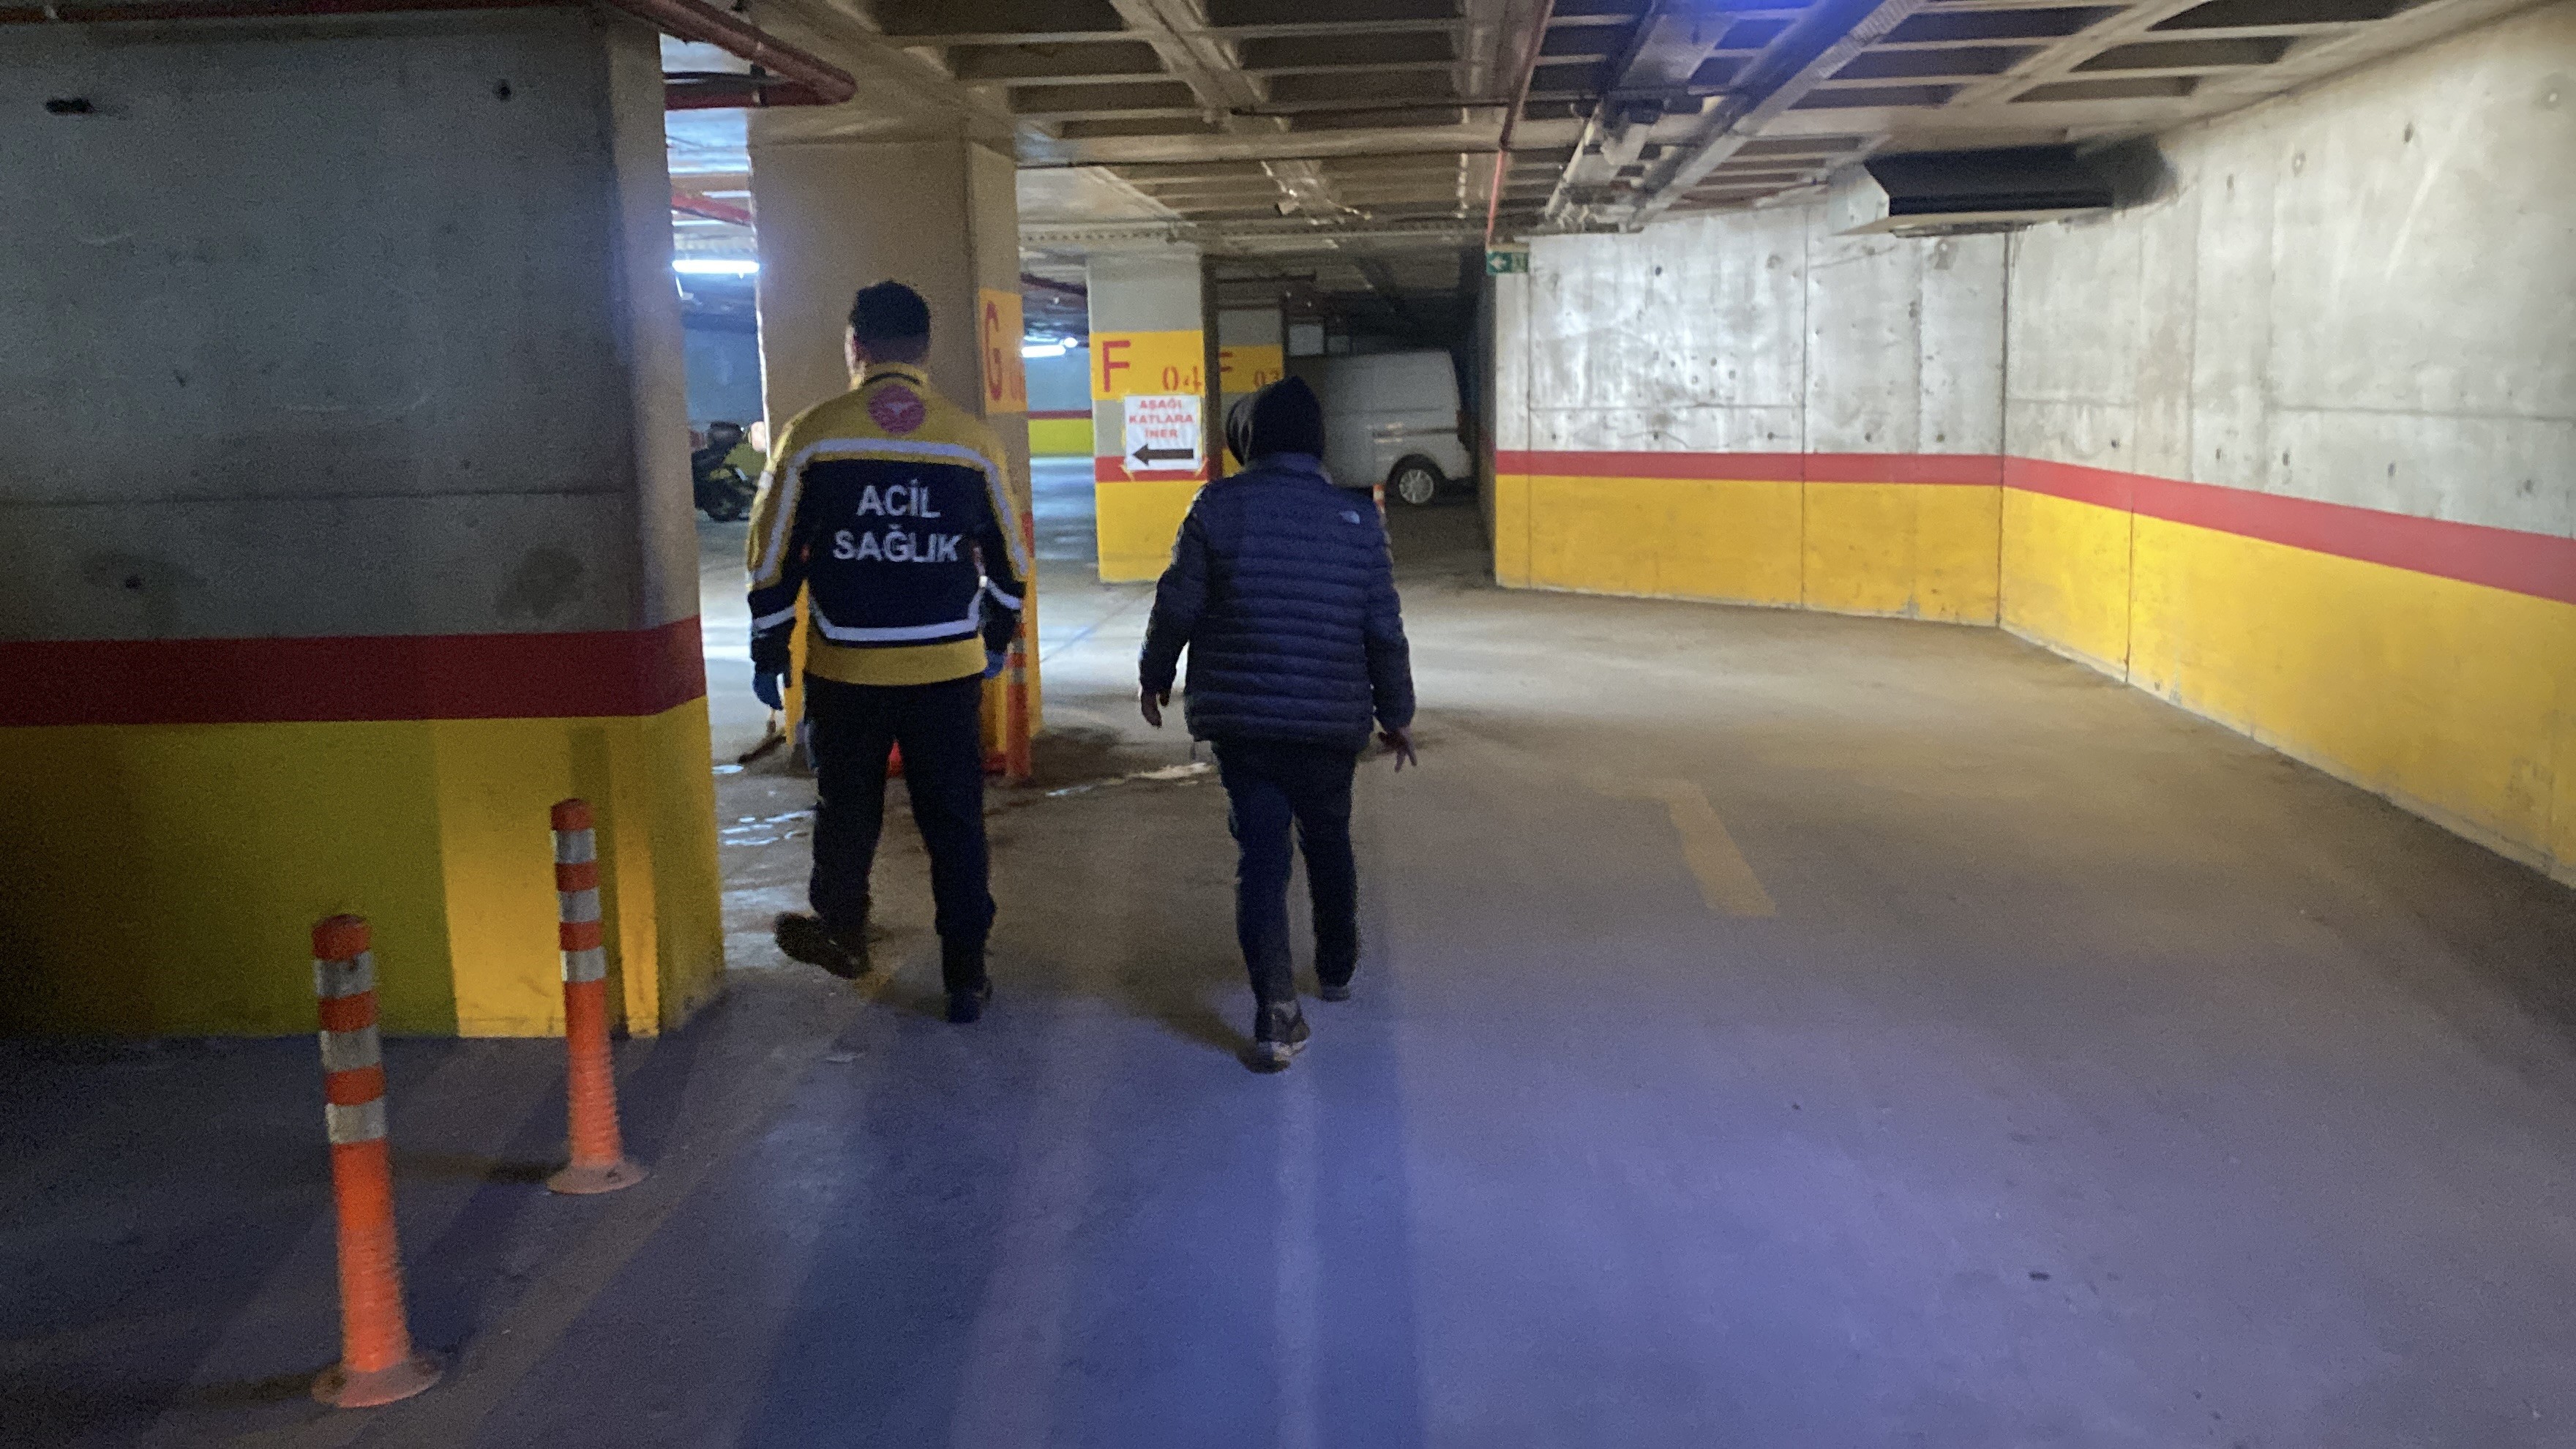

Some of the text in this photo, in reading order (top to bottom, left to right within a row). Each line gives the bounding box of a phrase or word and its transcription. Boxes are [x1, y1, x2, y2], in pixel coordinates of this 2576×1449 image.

[985, 302, 1003, 400] G
[1103, 340, 1131, 392] F
[1128, 414, 1194, 424] KATLARA
[1145, 427, 1178, 438] İNER
[855, 478, 941, 519] ACİL
[832, 523, 962, 564] SAĞLIK
